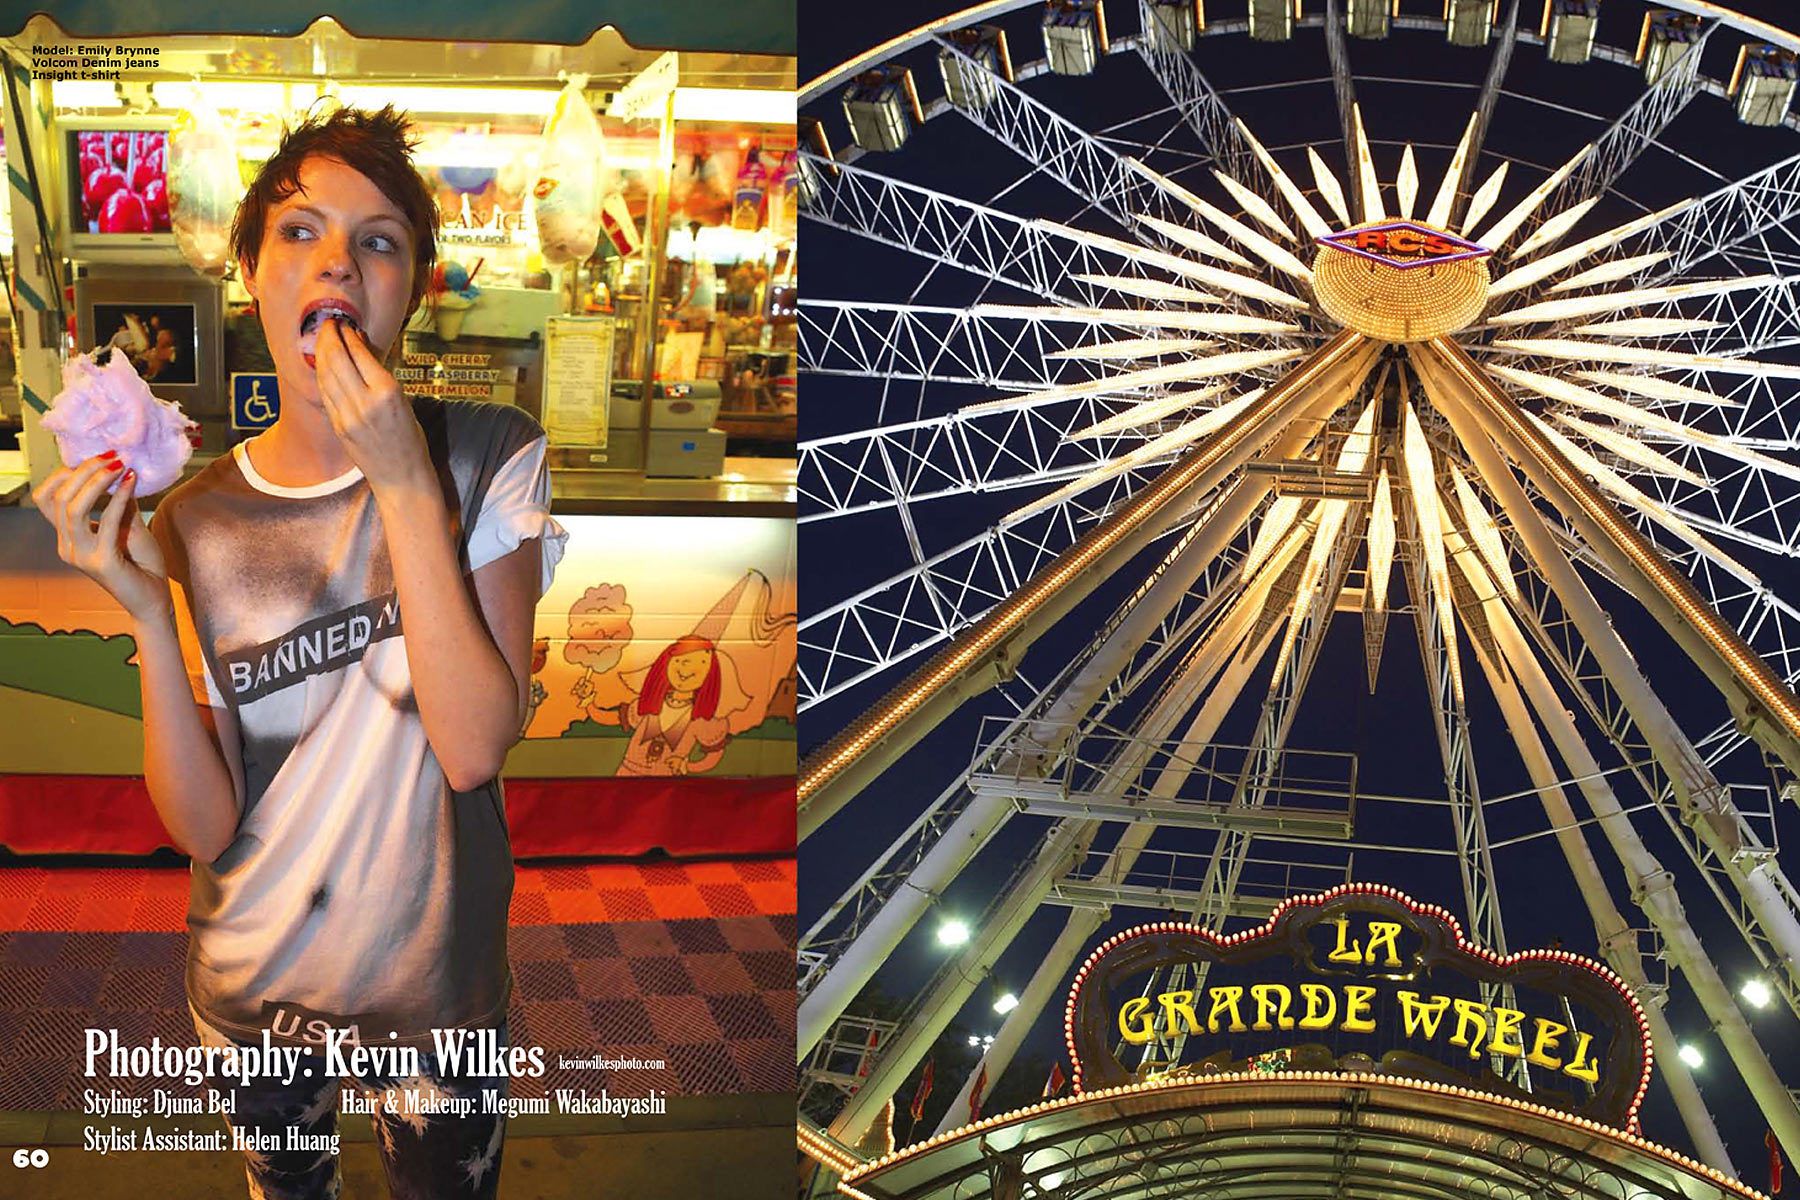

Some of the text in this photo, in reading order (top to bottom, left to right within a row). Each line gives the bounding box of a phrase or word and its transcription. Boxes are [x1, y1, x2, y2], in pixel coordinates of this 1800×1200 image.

[442, 211, 529, 230] CAN ICE
[452, 234, 473, 243] TWO
[1355, 231, 1453, 257] RCS
[405, 353, 491, 365] WILD CHERRY
[394, 368, 500, 381] BLUE RASPBERRY
[403, 383, 490, 396] WATERMELON
[229, 614, 372, 693] BANNED
[1328, 918, 1402, 967] LA
[272, 1008, 361, 1048] USA
[1118, 984, 1599, 1084] GRANDE WHEEL
